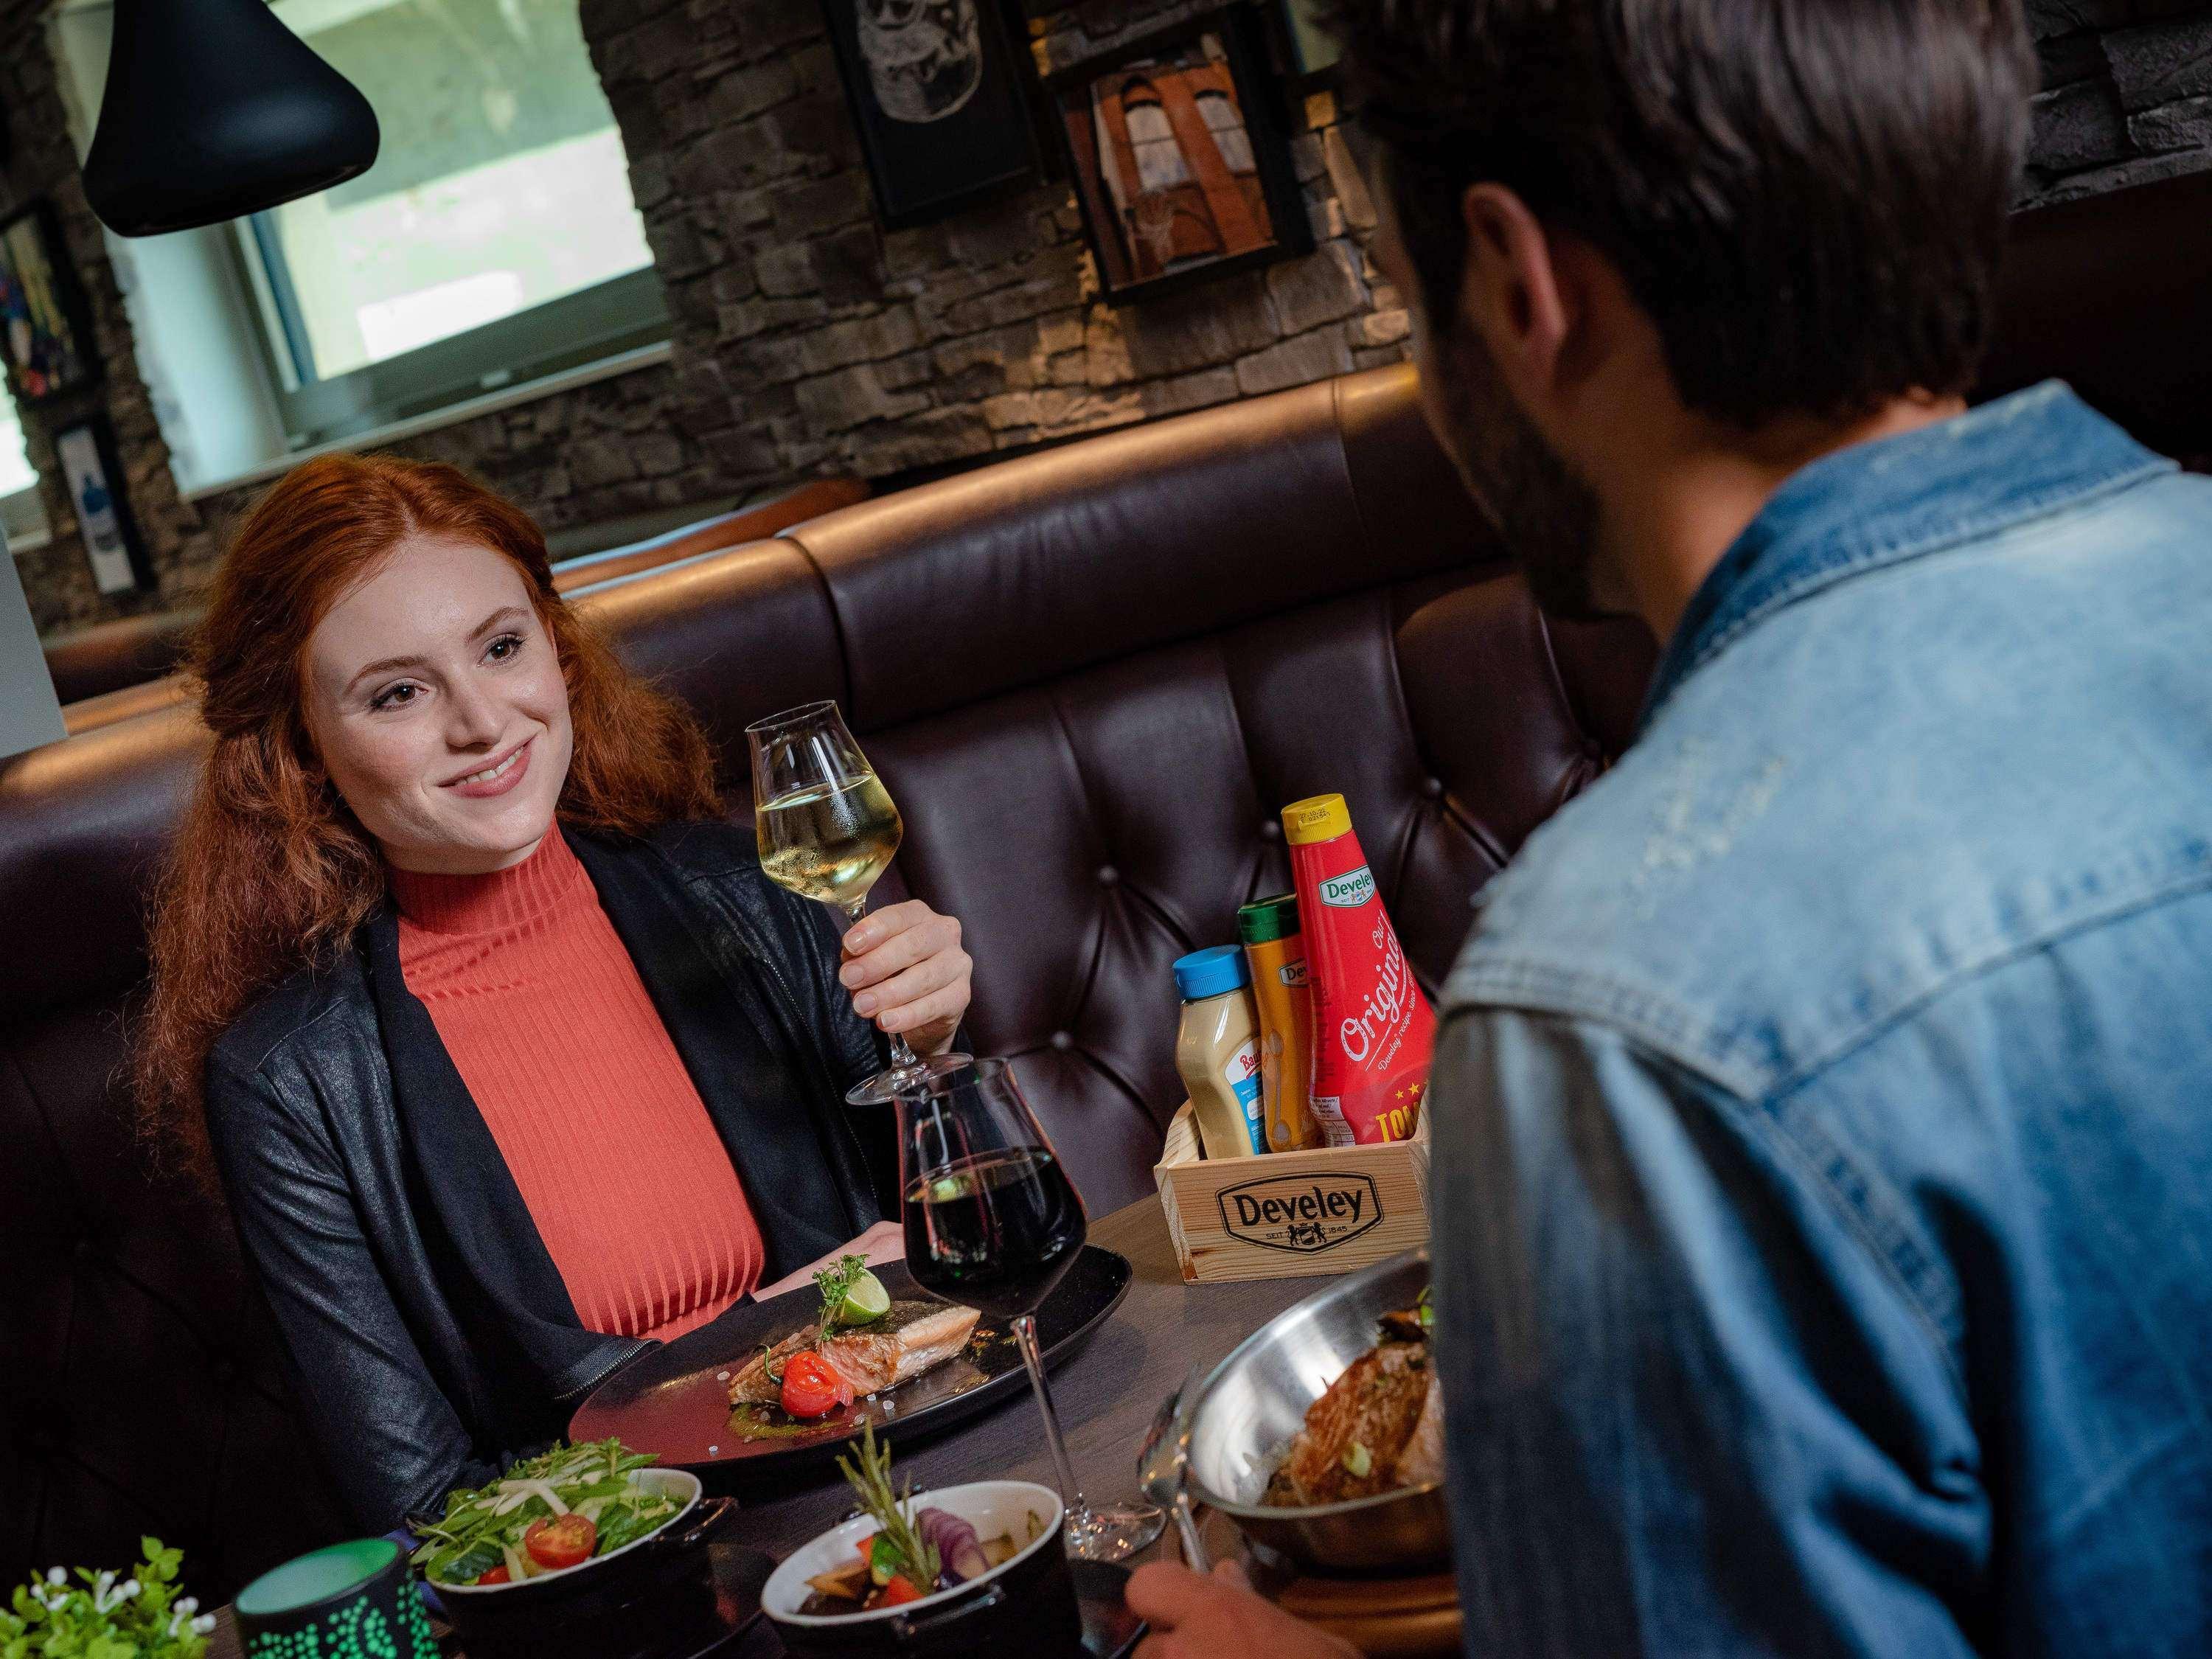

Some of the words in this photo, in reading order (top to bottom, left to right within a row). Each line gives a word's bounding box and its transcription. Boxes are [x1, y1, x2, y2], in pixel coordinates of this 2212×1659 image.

[1399, 1011, 1411, 1037] recipe
[1232, 1186, 1362, 1227] Develey
[1266, 1232, 1283, 1240] SEIT
[1329, 1225, 1348, 1234] 1845
